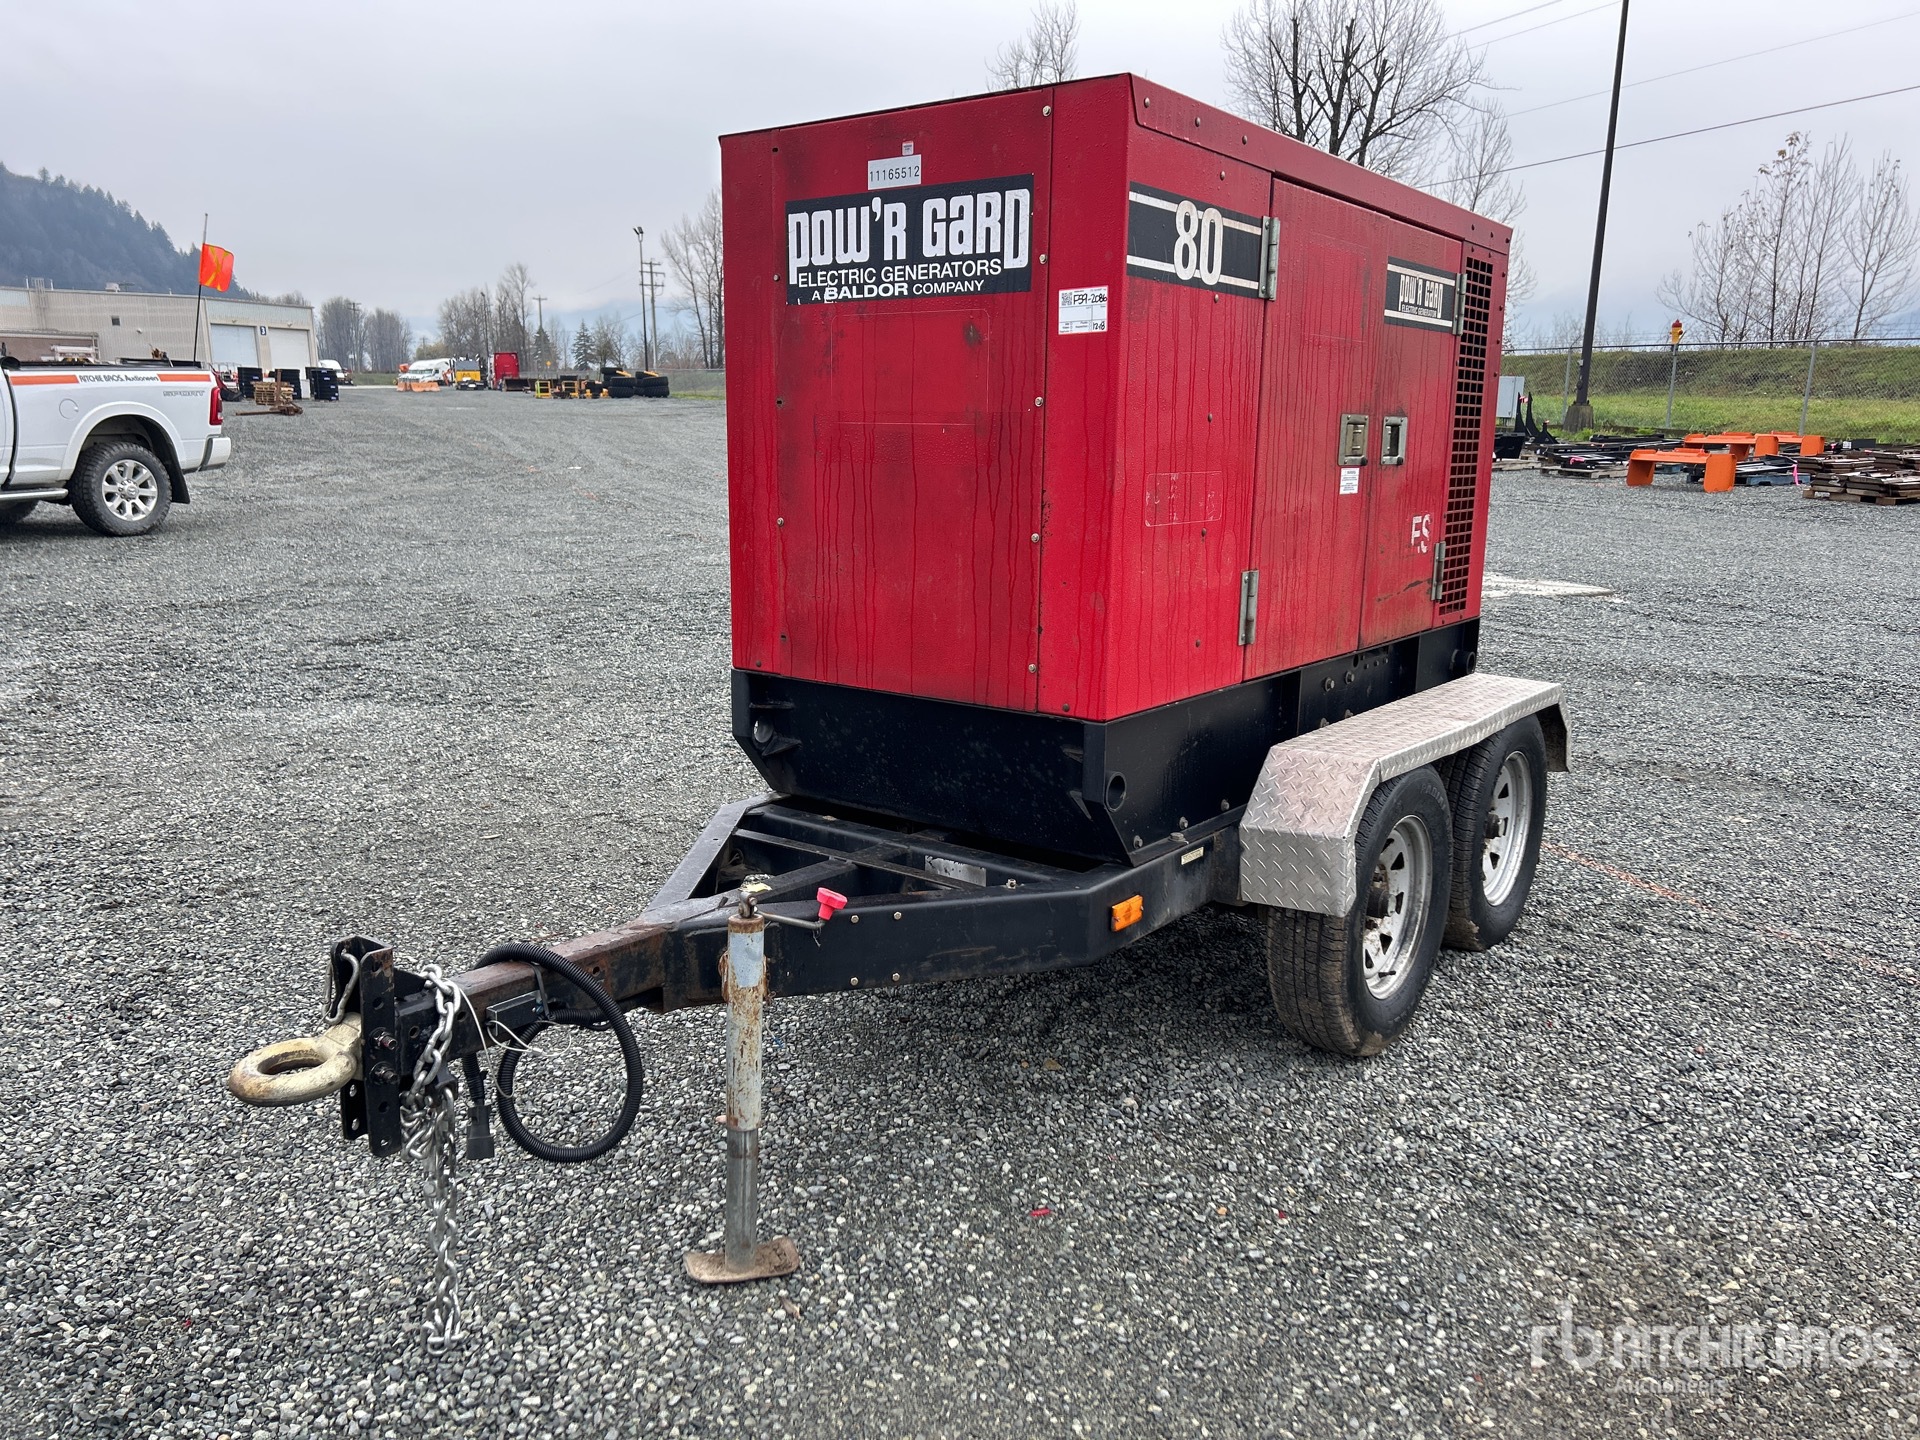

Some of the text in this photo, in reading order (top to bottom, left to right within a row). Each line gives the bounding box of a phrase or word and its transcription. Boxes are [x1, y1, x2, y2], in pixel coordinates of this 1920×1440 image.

[869, 165, 920, 182] 11165512
[1173, 199, 1224, 286] 80
[798, 258, 1002, 288] ELECTRIC GENERATORS
[811, 279, 985, 301] A BALDOR COMPANY
[79, 374, 103, 383] RITCHIE
